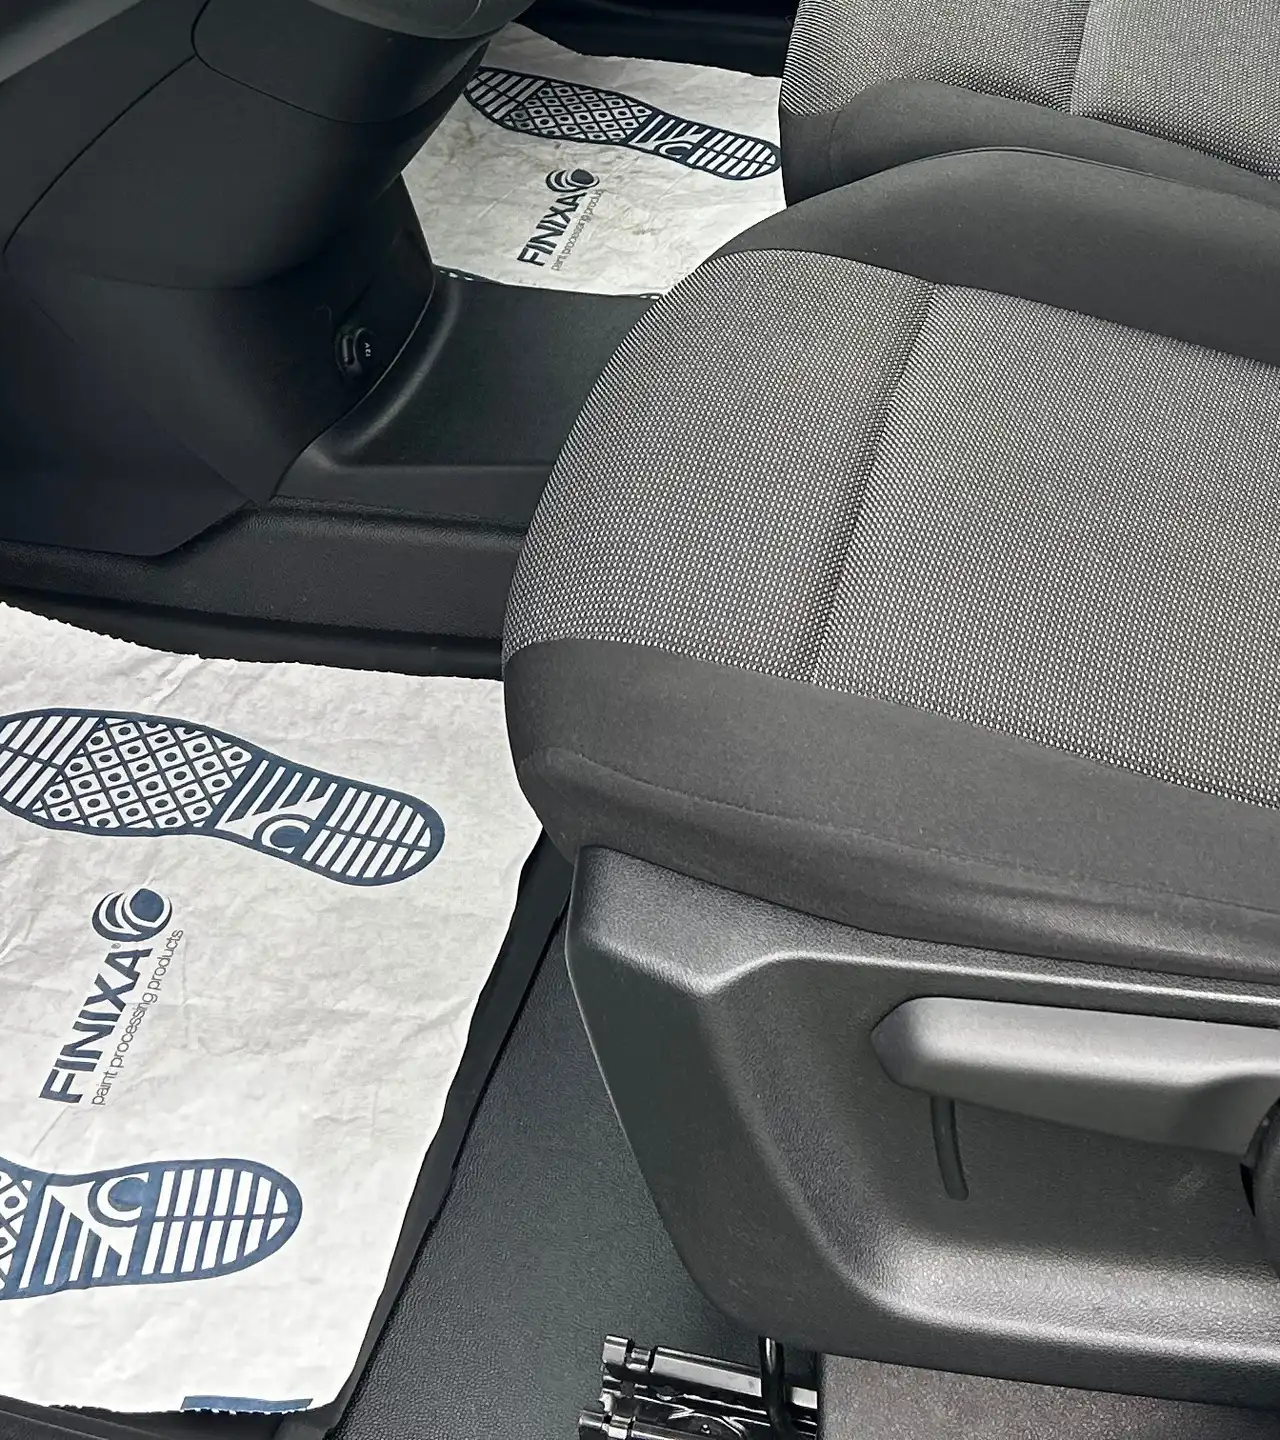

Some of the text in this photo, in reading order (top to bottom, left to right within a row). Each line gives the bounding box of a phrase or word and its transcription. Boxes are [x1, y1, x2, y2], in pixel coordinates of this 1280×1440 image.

[517, 192, 587, 267] FINIXA
[39, 947, 153, 1104] FINIXA
[91, 929, 183, 1106] paint processing products
